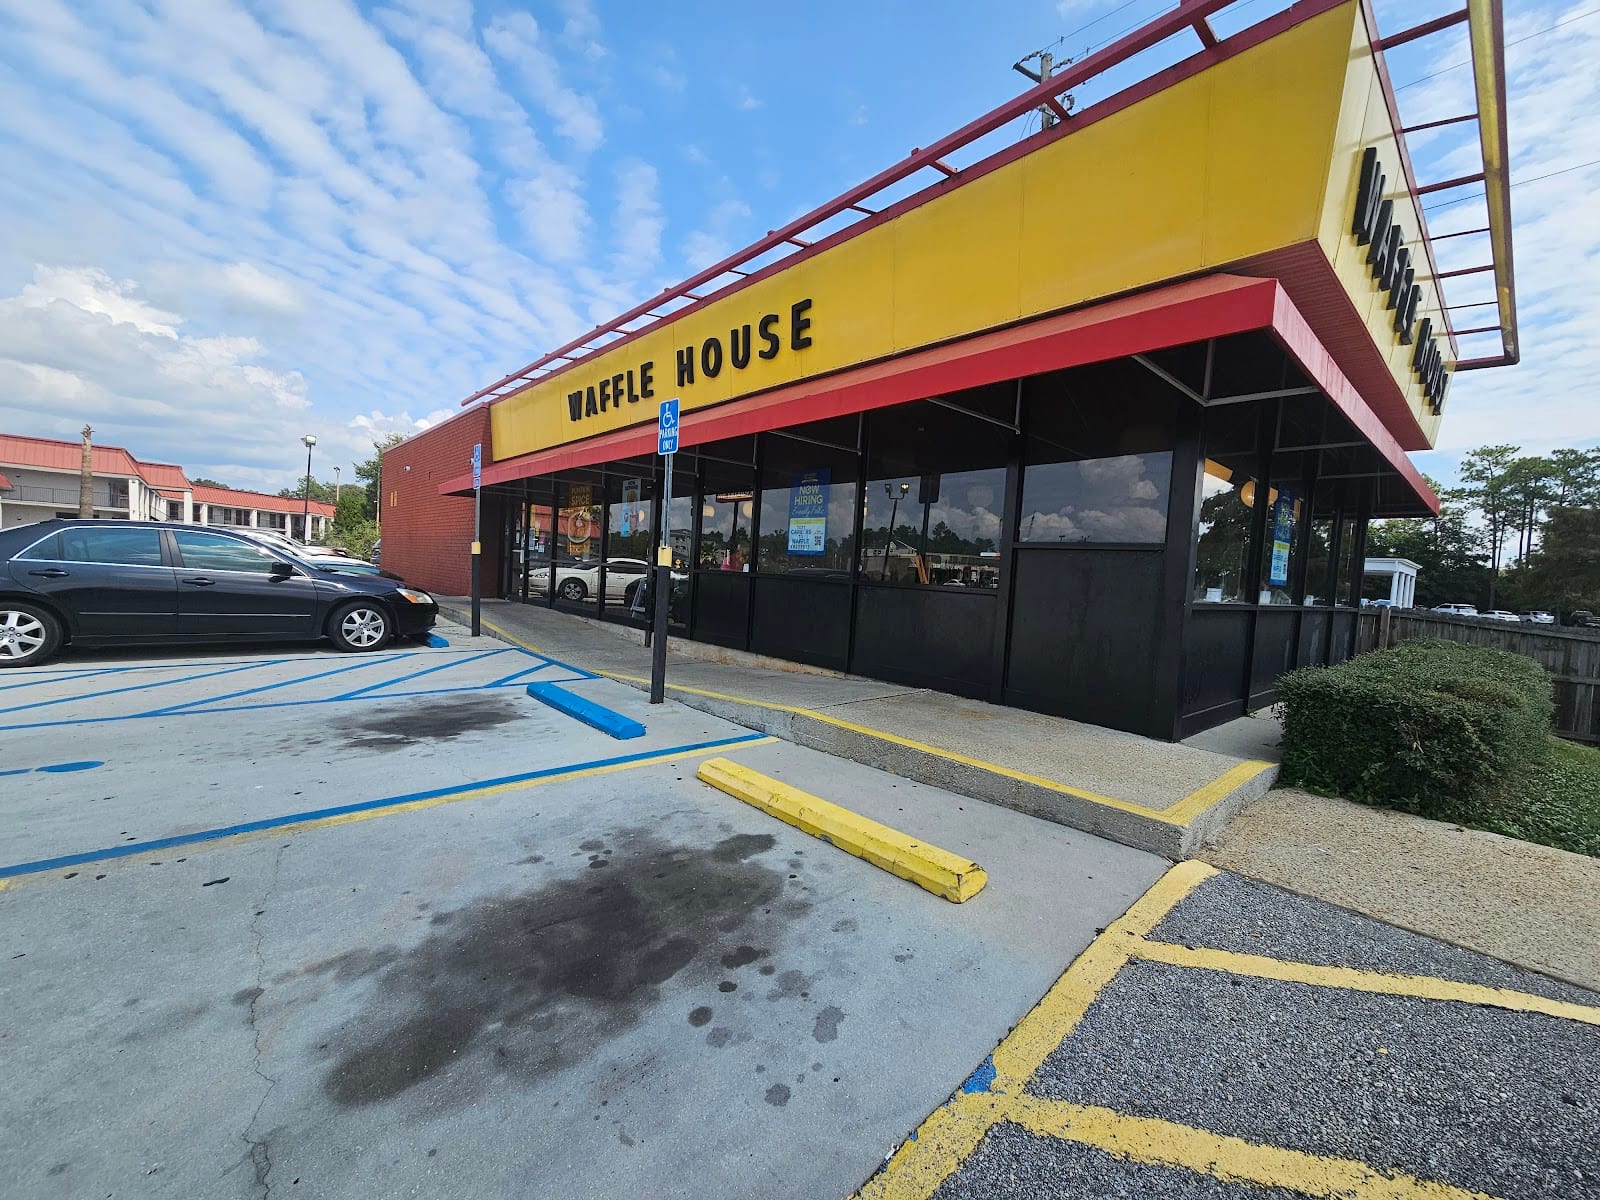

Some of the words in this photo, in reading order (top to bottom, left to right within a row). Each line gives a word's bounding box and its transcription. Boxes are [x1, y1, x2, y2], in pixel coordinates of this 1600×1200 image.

[567, 361, 655, 422] WAFFLE
[676, 298, 813, 387] HOUSE
[660, 427, 678, 439] PARKING
[662, 439, 674, 451] ONLY
[800, 485, 820, 495] NOW
[571, 495, 590, 505] SPICE
[794, 496, 823, 505] HIRING
